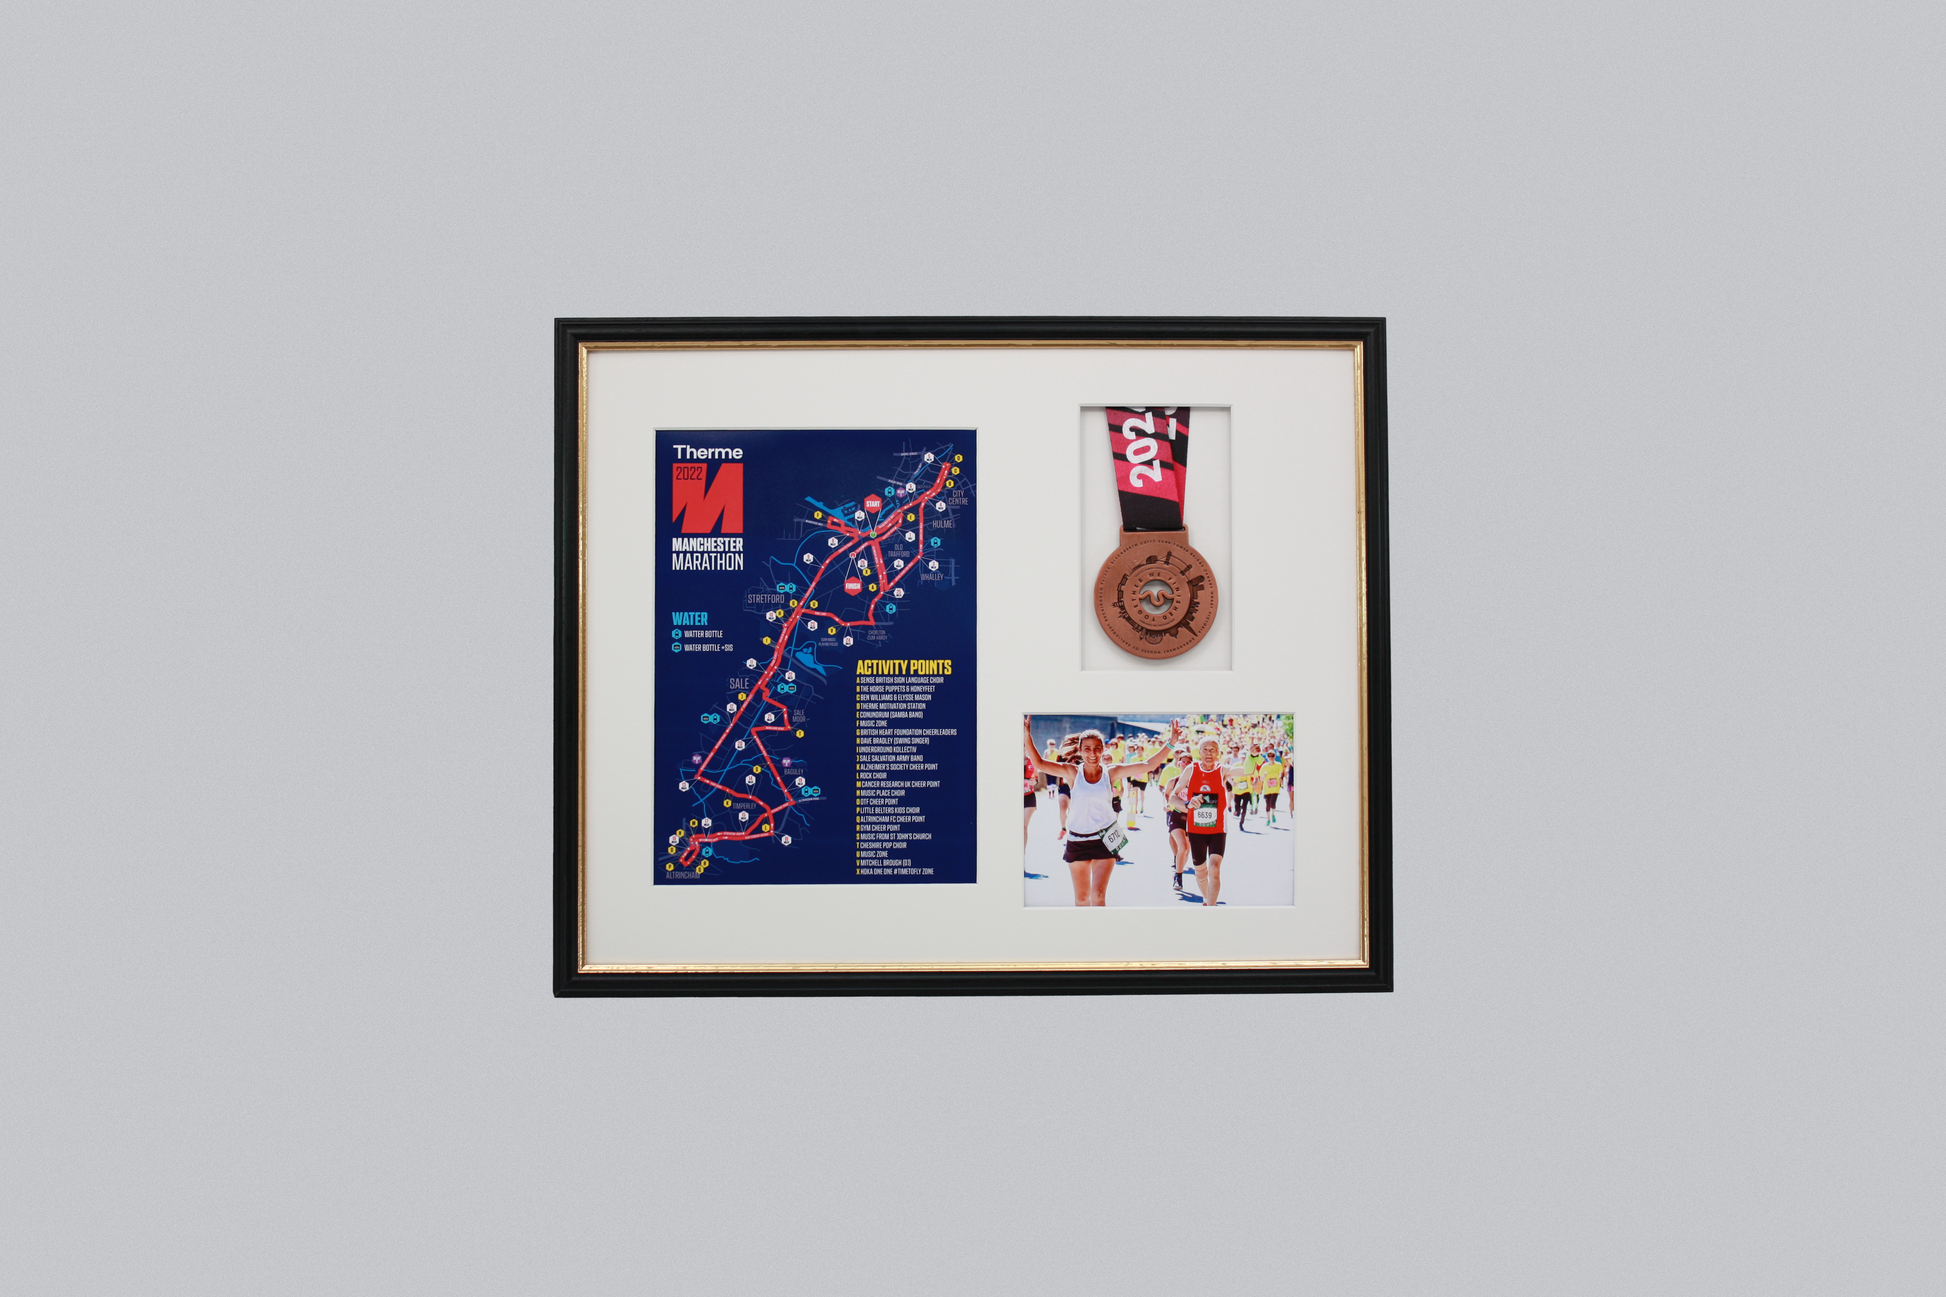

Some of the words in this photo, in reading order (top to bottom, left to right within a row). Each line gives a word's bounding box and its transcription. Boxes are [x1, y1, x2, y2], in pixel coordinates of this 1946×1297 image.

[673, 445, 743, 459] Therme
[1122, 407, 1162, 488] 202
[676, 466, 702, 480] 2022
[672, 537, 744, 552] MANCHESTER
[672, 553, 744, 570] MARATHON
[748, 594, 784, 603] STRETFORD
[1132, 578, 1155, 622] TOGETHER
[1162, 577, 1181, 620] FINISHED
[672, 612, 708, 625] WATER
[856, 659, 908, 675] ACTIVITY
[910, 659, 952, 675] POINTS
[730, 678, 749, 689] SALE
[1108, 830, 1120, 843] 6712
